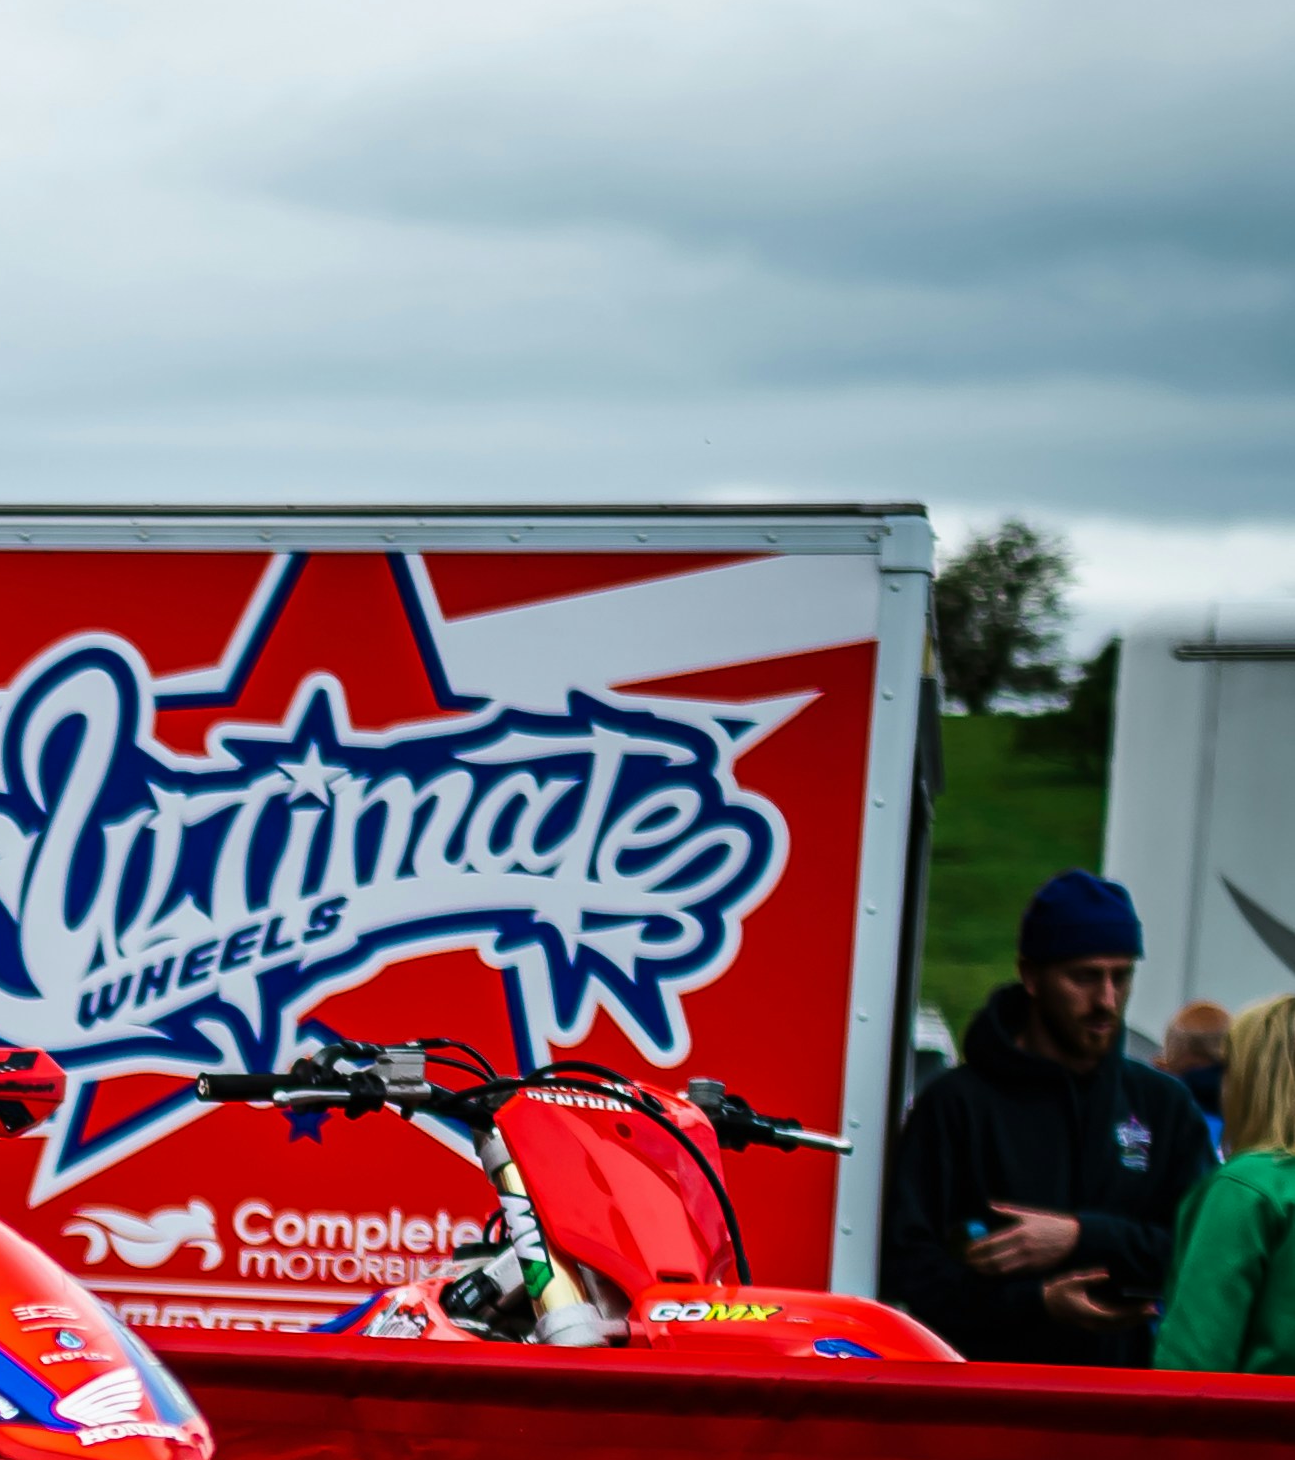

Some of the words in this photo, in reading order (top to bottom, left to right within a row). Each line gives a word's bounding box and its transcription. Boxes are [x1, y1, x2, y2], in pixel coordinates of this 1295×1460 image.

[75, 900, 348, 1028] WHEELS
[233, 1199, 486, 1254] Complete
[648, 1301, 784, 1323] GOMX
